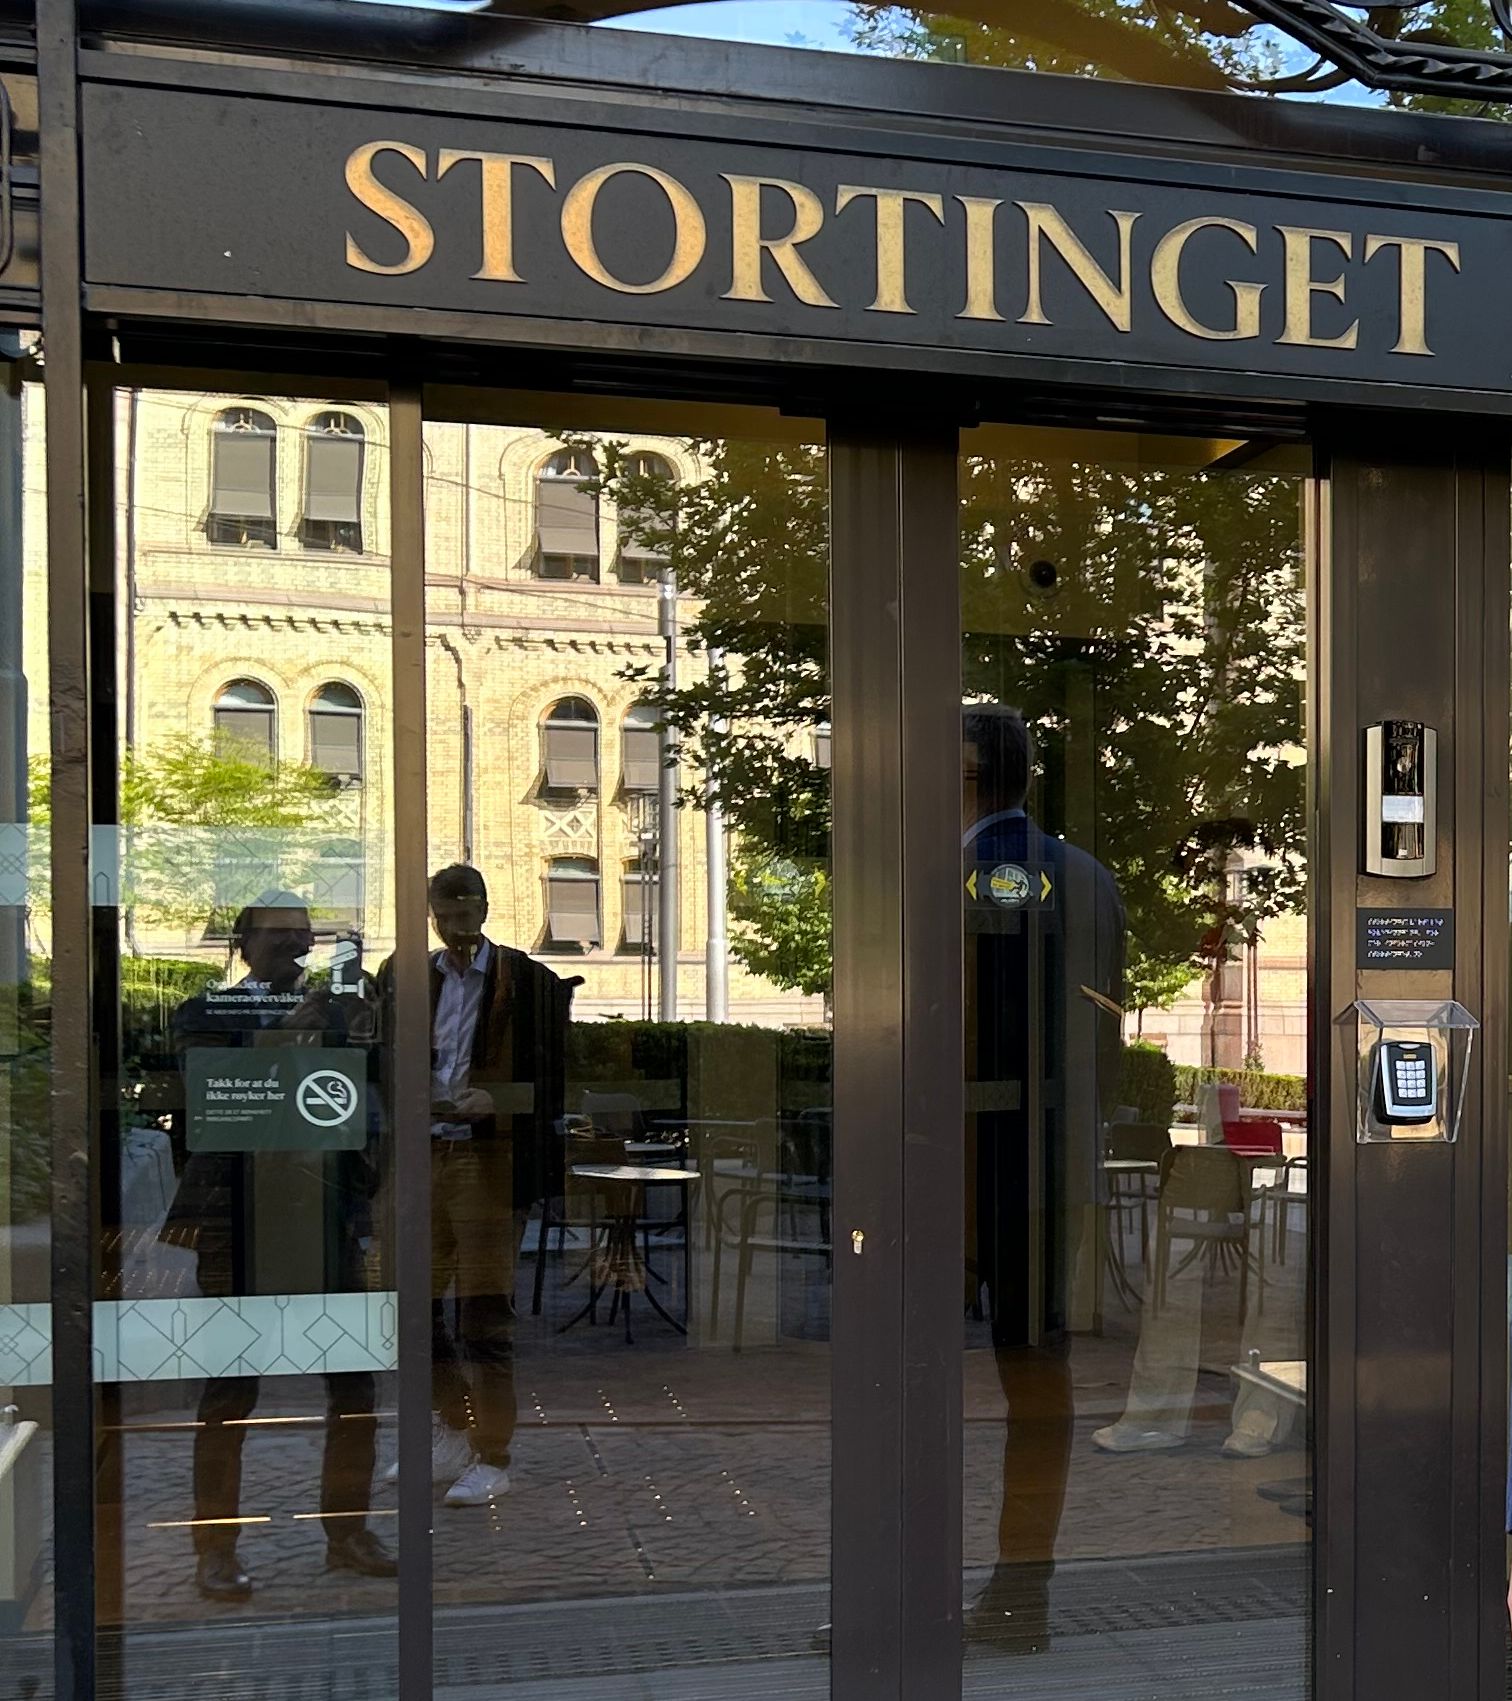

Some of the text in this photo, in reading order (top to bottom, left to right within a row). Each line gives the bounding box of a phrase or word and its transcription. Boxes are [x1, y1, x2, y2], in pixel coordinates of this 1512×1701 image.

[345, 139, 1462, 357] STORTINGET
[206, 1078, 280, 1088] Takk for at du
[206, 1090, 230, 1100] ikke
[267, 1090, 286, 1100] her
